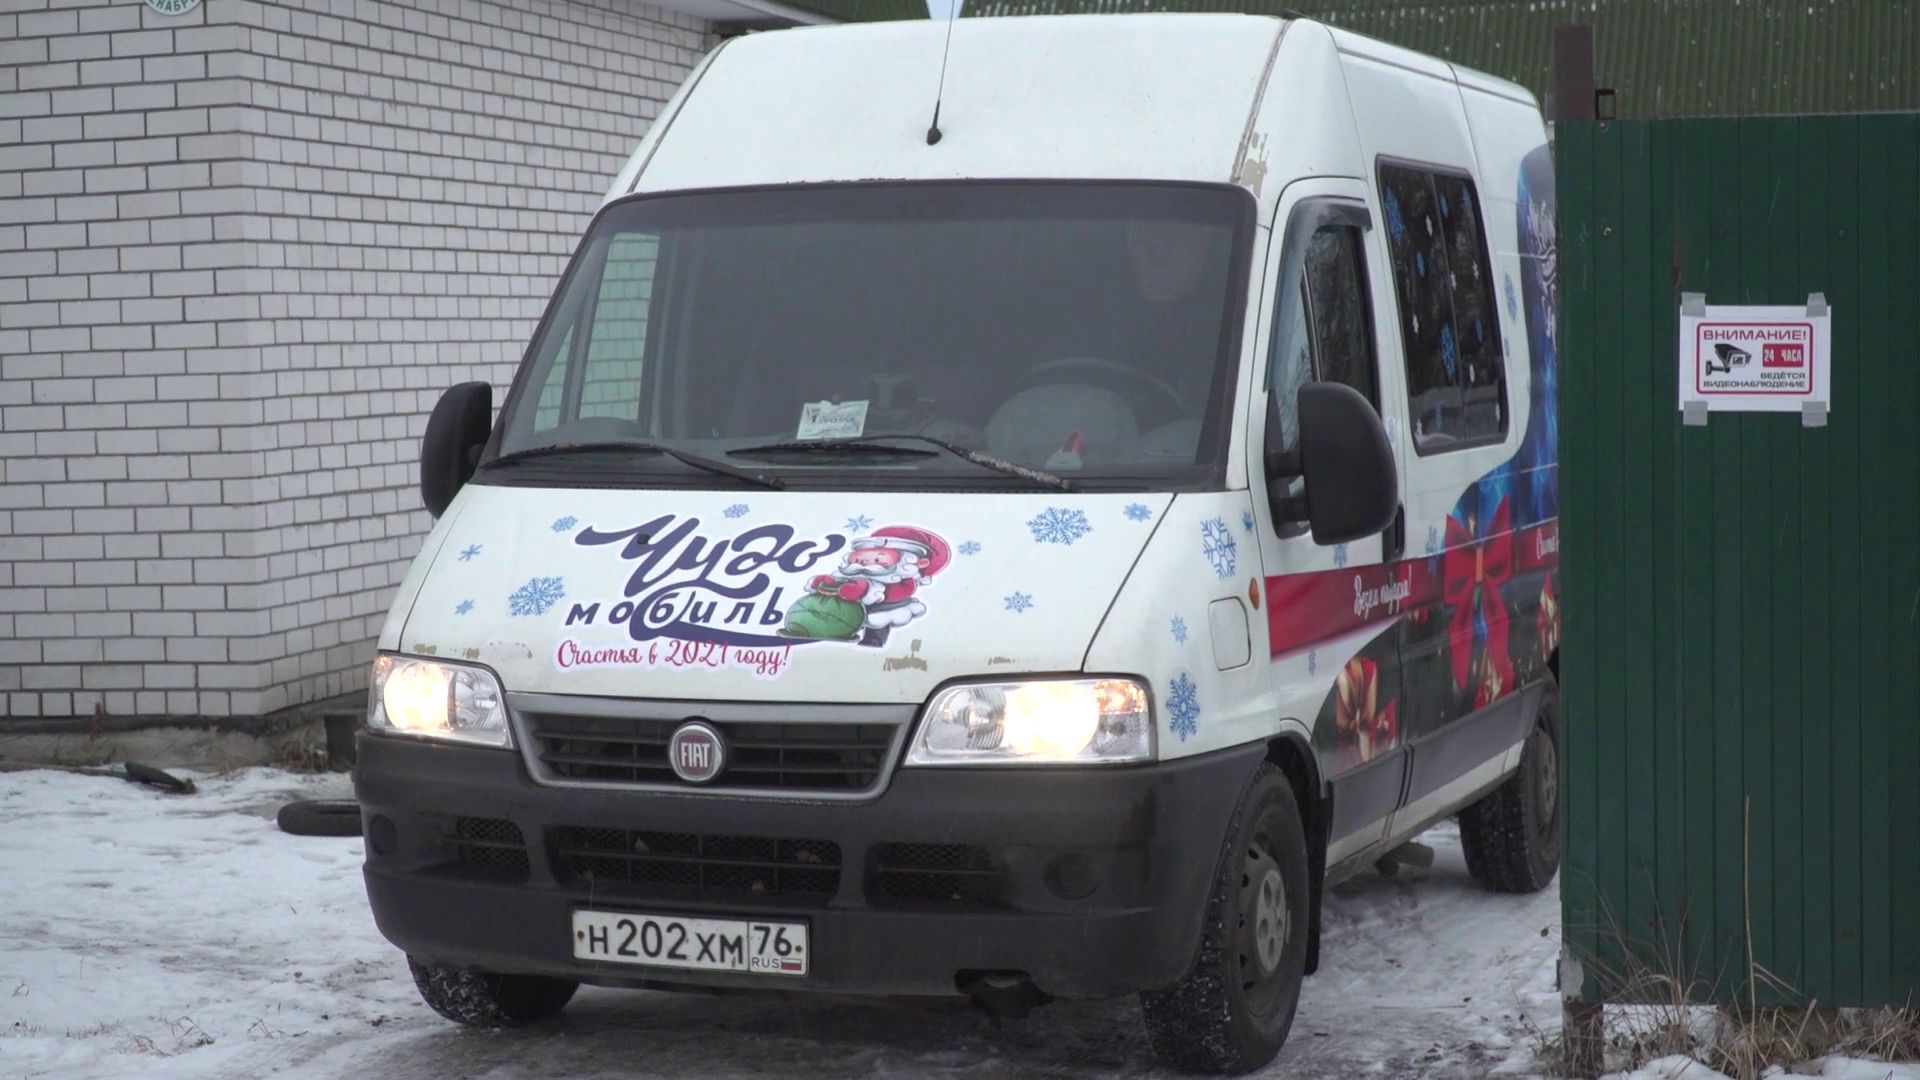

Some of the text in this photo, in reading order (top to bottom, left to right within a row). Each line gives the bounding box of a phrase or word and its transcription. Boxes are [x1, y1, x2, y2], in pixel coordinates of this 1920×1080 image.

[1703, 330, 1807, 341] ВНИМАНИЕ!
[1764, 349, 1802, 362] 24 ЧАСА
[1760, 371, 1806, 380] ВЕДЁТСЯ
[1703, 380, 1805, 389] ВИДЕОНАБЛЮДЕНИЕ
[575, 513, 846, 599] Чудо
[557, 639, 792, 675] Счастья в 2021 году!
[681, 742, 711, 768] FIAT
[753, 925, 793, 956] 76
[751, 957, 780, 969] RUS
